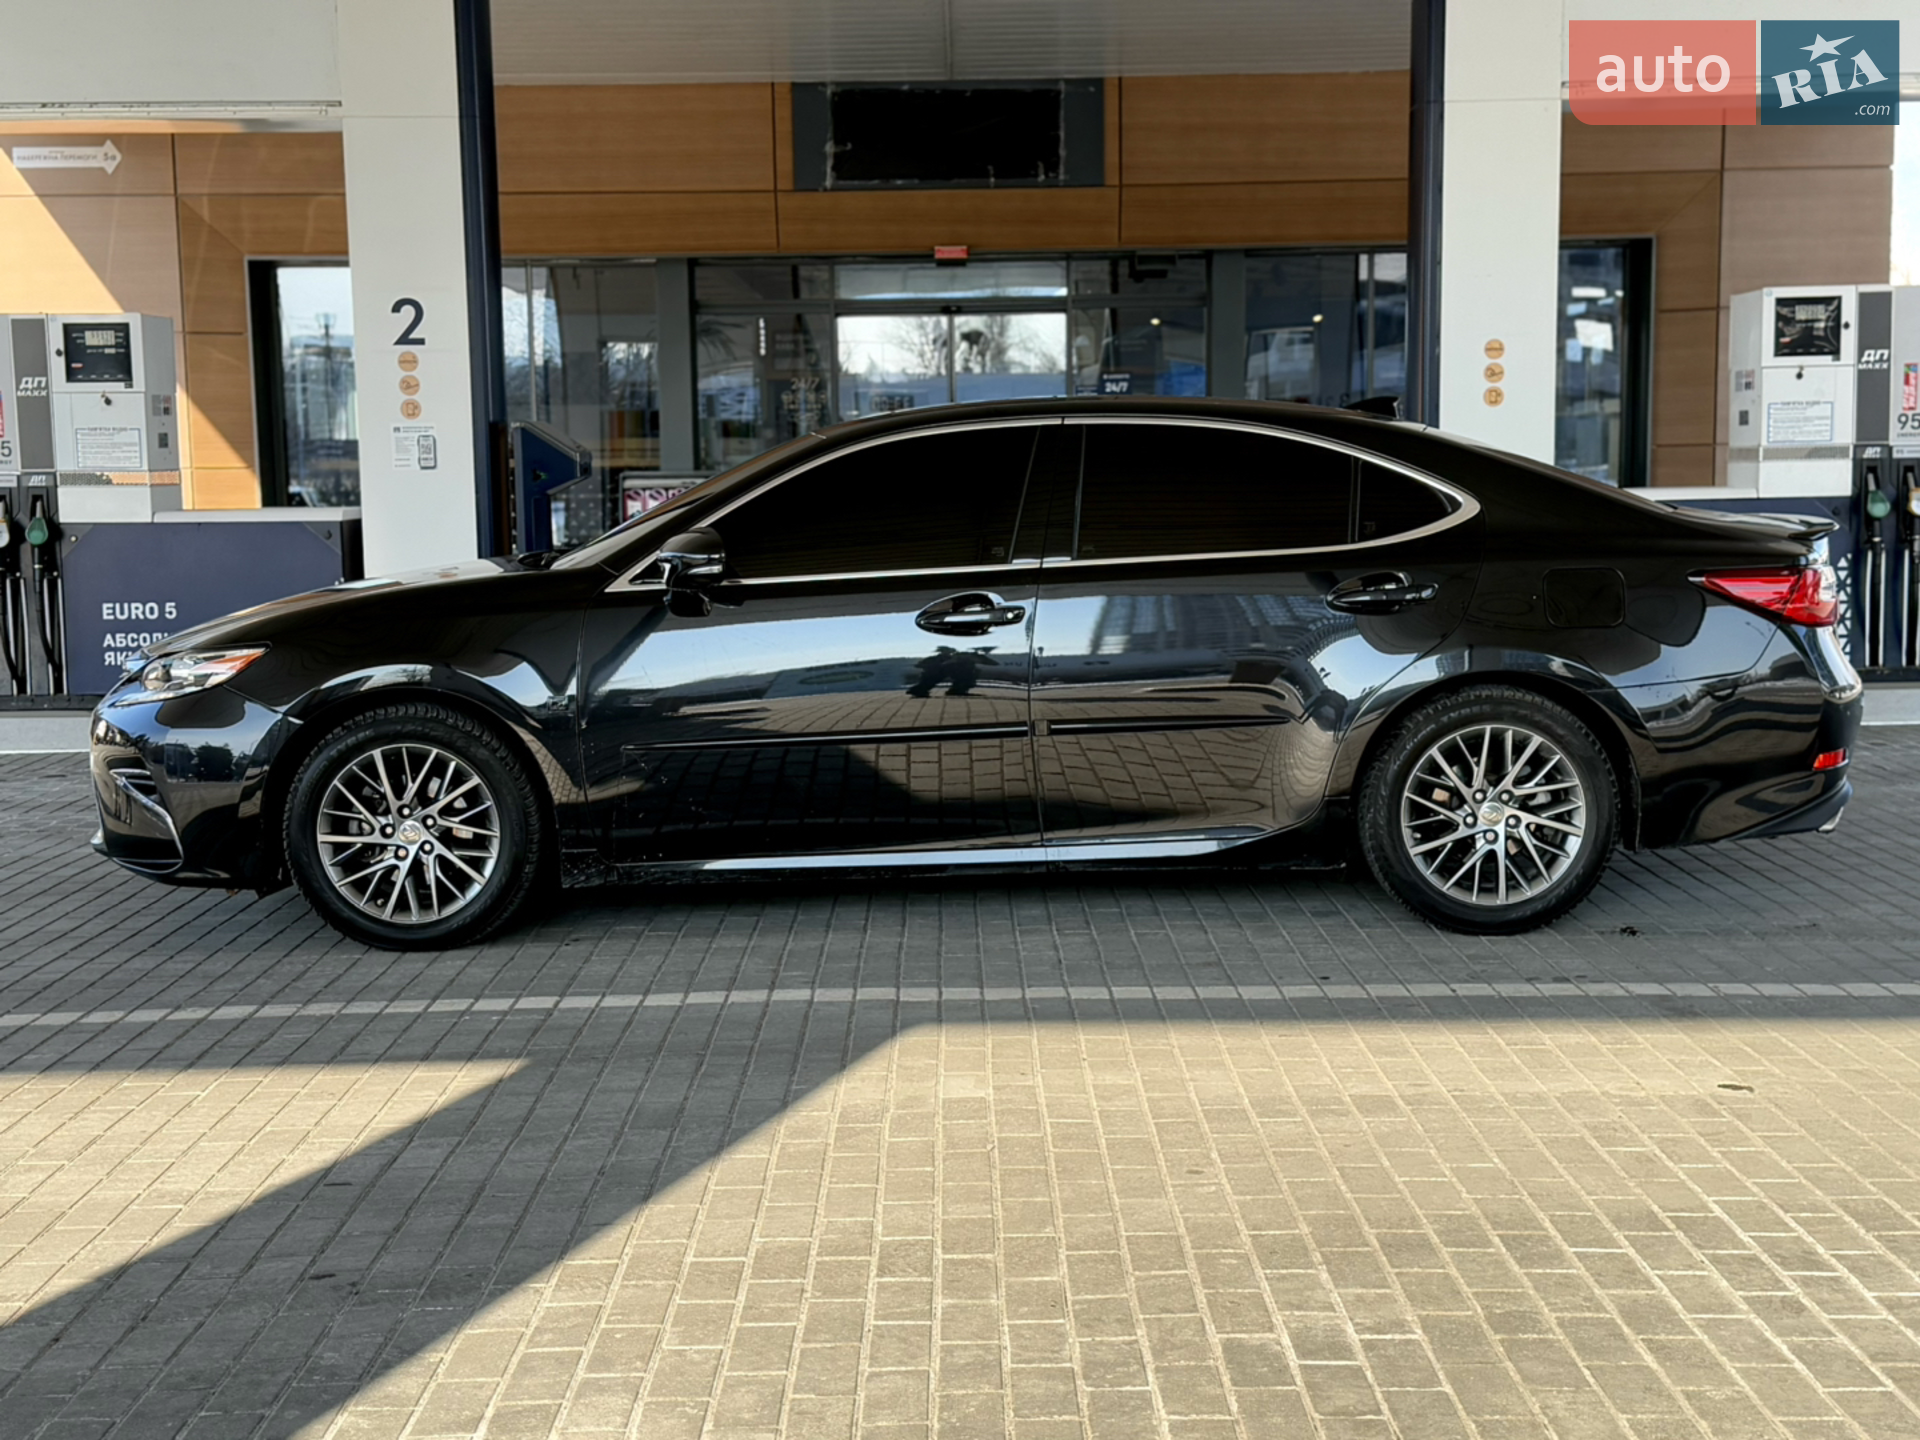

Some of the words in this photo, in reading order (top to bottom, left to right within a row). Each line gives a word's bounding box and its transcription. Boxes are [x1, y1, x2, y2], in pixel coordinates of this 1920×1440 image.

[391, 297, 426, 346] 2
[1861, 348, 1889, 362] ДП
[19, 376, 47, 389] ДП
[1104, 380, 1129, 394] 24/7
[1897, 412, 1920, 431] 95
[102, 602, 159, 620] EURO
[164, 602, 177, 620] 5
[103, 632, 169, 648] АБСОЛ
[104, 651, 132, 667] ЯК
